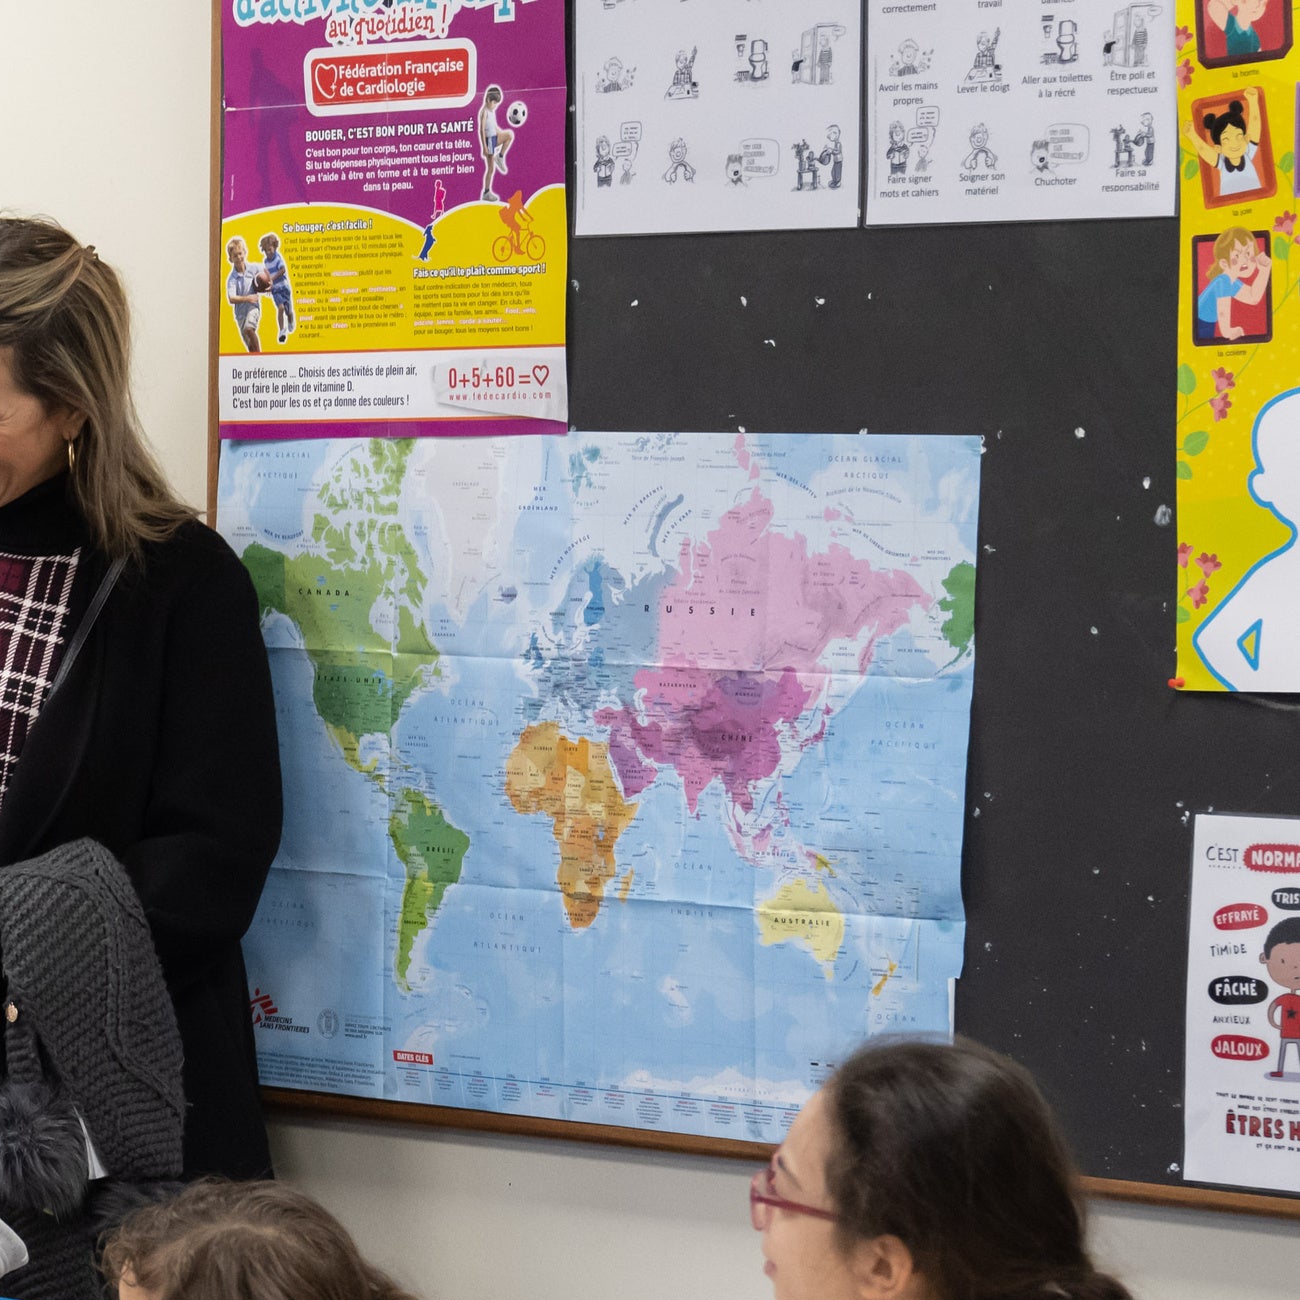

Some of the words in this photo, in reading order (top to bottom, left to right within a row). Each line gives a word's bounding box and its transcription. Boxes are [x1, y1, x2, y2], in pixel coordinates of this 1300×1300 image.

[881, 2, 937, 14] correctement
[328, 20, 349, 39] au
[354, 10, 435, 45] quotidien
[338, 62, 402, 80] Fédération
[405, 57, 464, 76] Française
[1022, 74, 1040, 86] Aller
[1042, 76, 1058, 85] aux
[1059, 73, 1093, 85] toilettes
[1110, 69, 1127, 81] Être
[1129, 71, 1145, 84] poli
[1146, 71, 1155, 81] et
[339, 82, 354, 97] de
[356, 79, 426, 98] Cardiologie
[878, 81, 900, 93] Avoir
[901, 81, 913, 92] les
[914, 80, 938, 92] mains
[957, 84, 979, 95] Lever
[980, 83, 988, 94] le
[989, 82, 1010, 96] doigt
[1045, 87, 1053, 98] la
[1054, 87, 1076, 97] récré
[1106, 85, 1158, 97] respectueux
[892, 98, 924, 107] propres
[305, 129, 346, 142] BOUGER,
[348, 126, 374, 139] C'EST
[376, 125, 395, 137] BON
[398, 123, 424, 136] POUR
[426, 122, 438, 134] TA
[441, 117, 474, 133] SANTÉ
[959, 172, 989, 185] Soigner
[990, 172, 1005, 182] son
[1115, 168, 1135, 178] Faire
[1137, 169, 1147, 178] sa
[887, 174, 907, 185] Faire
[908, 174, 932, 187] signer
[1034, 176, 1077, 187] Chuchoter
[880, 188, 899, 198] mots
[901, 188, 910, 198] et
[911, 187, 939, 198] cahiers
[965, 185, 999, 196] matériel
[1101, 181, 1160, 194] responsabilité
[283, 222, 294, 233] Se
[295, 221, 325, 235] bouger,
[326, 220, 346, 231] c'est
[346, 219, 368, 230] facile
[413, 268, 429, 278] Fais
[430, 268, 439, 277] ce
[457, 266, 465, 277] te
[487, 266, 517, 276] comme
[518, 263, 541, 277] sport
[232, 368, 242, 380] De
[244, 367, 288, 382] préférence
[298, 367, 326, 378] Choisis
[327, 366, 341, 378] des
[342, 365, 374, 378] activités
[375, 365, 385, 377] de
[385, 364, 404, 379] plein
[405, 364, 418, 377] air,
[232, 385, 250, 396] pour
[252, 382, 270, 395] faire
[271, 382, 280, 394] le
[281, 382, 300, 396] plein
[301, 381, 312, 393] de
[313, 380, 345, 393] vitamine
[232, 398, 251, 410] C'est
[253, 397, 268, 409] bon
[269, 398, 288, 411] pour
[289, 396, 301, 408] les
[302, 398, 312, 408] os
[313, 396, 322, 408] et
[323, 398, 332, 411] ça
[333, 395, 357, 407] donne
[358, 395, 372, 407] des
[373, 394, 404, 407] couleurs
[299, 588, 350, 597] CANADA
[644, 604, 756, 617] RUSSIE
[721, 734, 753, 743] CHINE
[1206, 843, 1239, 862] C'EST
[774, 916, 830, 927] AUSTRALIE
[1215, 905, 1260, 925] EFFRAYÉ
[1215, 977, 1258, 997] FÂCHÉ
[259, 1021, 274, 1030] SANS
[1214, 1040, 1263, 1056] JALOUX
[397, 1052, 414, 1062] DATES
[1226, 1109, 1285, 1140] ÊTRES
